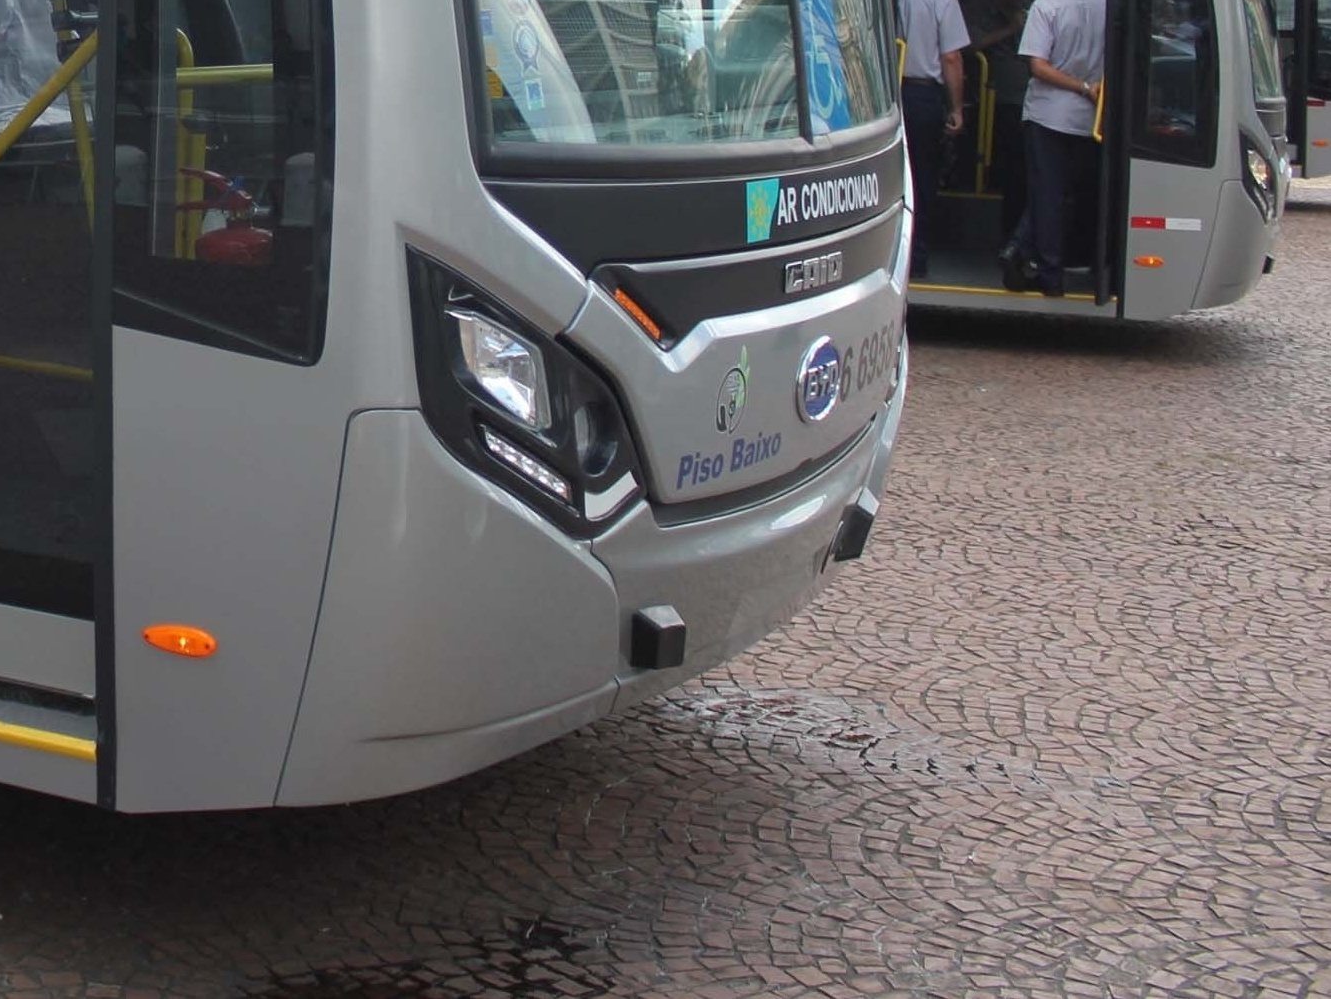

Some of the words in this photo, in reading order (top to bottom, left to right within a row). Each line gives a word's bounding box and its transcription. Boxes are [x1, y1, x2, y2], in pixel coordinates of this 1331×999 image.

[777, 187, 798, 226] AR
[801, 172, 879, 220] CONDICIONADO
[785, 251, 842, 294] CAIO
[803, 359, 839, 398] BYD
[839, 346, 853, 402] 6
[676, 452, 724, 490] Piso
[730, 432, 782, 473] Baixo
